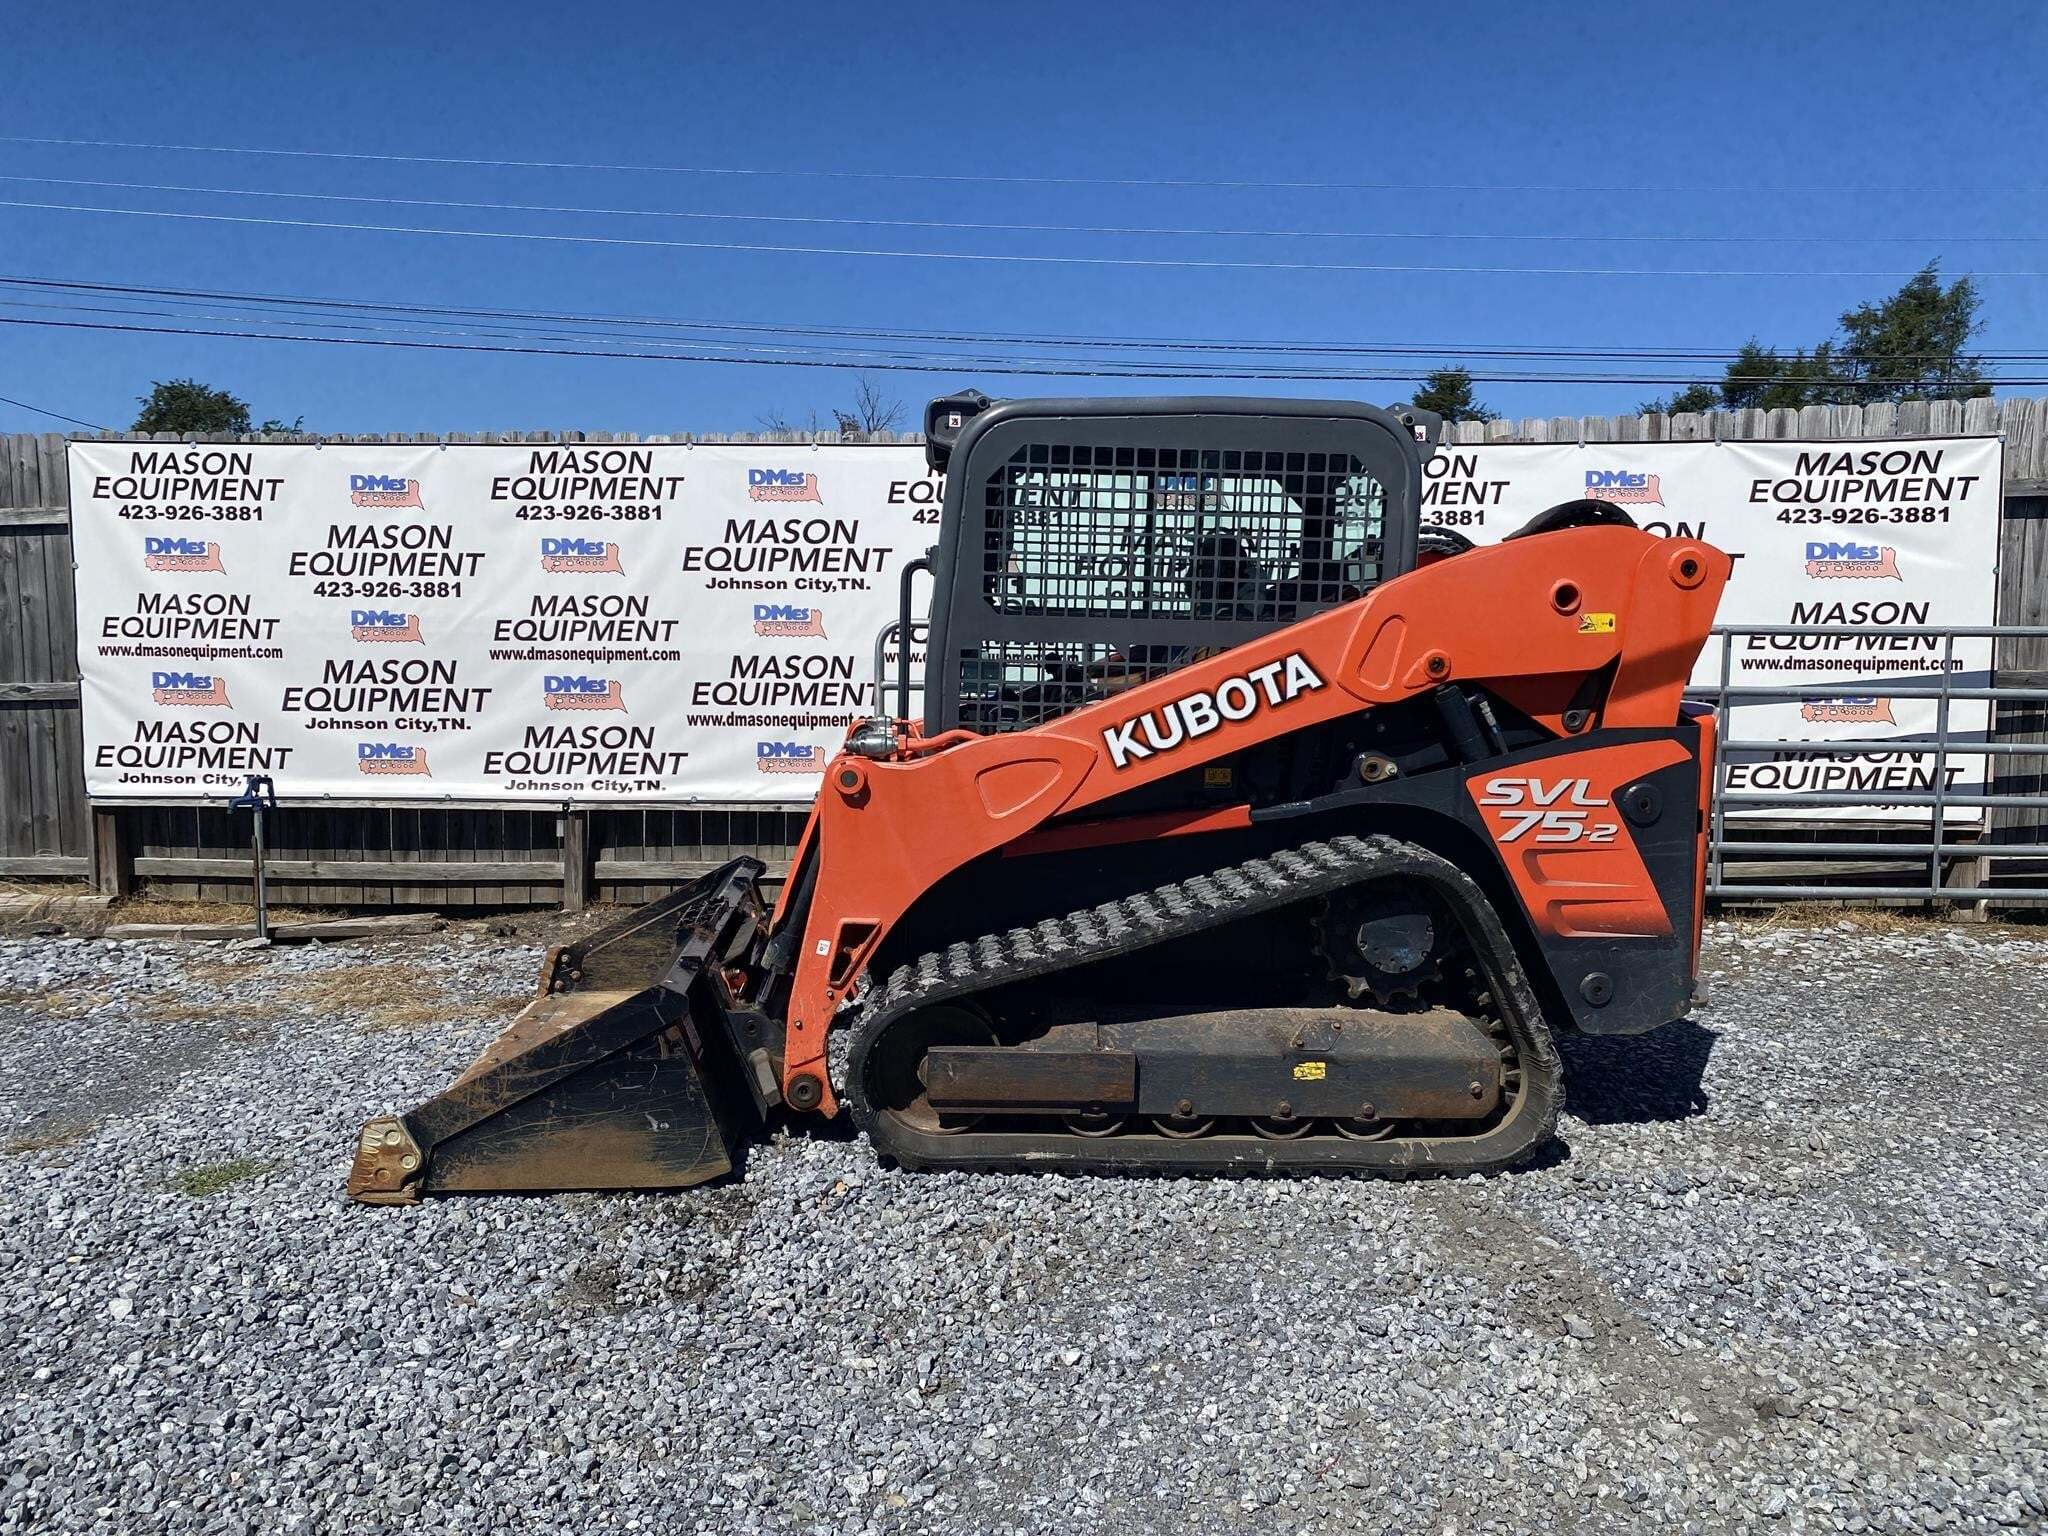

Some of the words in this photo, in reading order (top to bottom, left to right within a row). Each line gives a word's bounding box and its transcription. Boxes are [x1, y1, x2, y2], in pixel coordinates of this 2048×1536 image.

[131, 452, 252, 475] MASON
[530, 451, 652, 474] MASON
[1795, 450, 1944, 475] MASON
[351, 475, 405, 491] DMes
[749, 469, 804, 485] DMes
[1586, 471, 1645, 487] DMes
[93, 477, 284, 501] EQUIPMENT
[491, 477, 684, 500] EQUIPMENT
[1749, 477, 1979, 503] EQUIPMENT
[119, 505, 262, 520] 423-926-3881
[516, 505, 661, 520] 423-926-3881
[1777, 507, 1949, 523] 423-926-3881
[328, 525, 452, 549] MASON
[725, 519, 858, 544] MASON
[145, 537, 205, 554] DMes
[542, 538, 603, 555] DMes
[1806, 543, 1878, 560] DMes
[289, 552, 485, 576] EQUIPMENT
[683, 547, 892, 572] EQUIPMENT
[314, 582, 460, 597] 423-926-3881
[706, 578, 787, 589] Johnson
[795, 578, 870, 592] City,TN.
[138, 593, 250, 615] MASON
[531, 596, 648, 617] MASON
[754, 605, 808, 620] DMes
[1791, 602, 1929, 624] MASON
[103, 617, 280, 639] EQUIPMENT
[351, 610, 405, 626] DMes
[494, 620, 678, 641] EQUIPMENT
[98, 643, 282, 661] www.dmasonequipment.com
[1747, 635, 1941, 651] EQUIPMEN
[490, 647, 680, 664] www.dmasonequipment.com
[324, 660, 457, 684] MASON
[731, 655, 854, 679] MASON
[152, 672, 211, 688] DMes
[544, 676, 605, 692] DMes
[282, 687, 492, 712] EQUIPMENT
[1103, 653, 1324, 768] KUBOTA
[135, 721, 259, 744] MASON
[305, 718, 387, 729] Johnson
[395, 718, 471, 732] City,TN.
[524, 726, 655, 749] MASON
[95, 746, 293, 769] EQUIPMENT
[358, 743, 412, 758] DMes
[757, 742, 810, 757] DMes
[484, 752, 688, 774] EQUIPMENT
[119, 773, 195, 783] Johnson
[506, 780, 583, 790] Johnson
[591, 780, 666, 793] City,TN.
[1726, 765, 1964, 790] EQUIPMENT
[1479, 778, 1609, 807] SVL
[1498, 811, 1618, 842] 75-2
